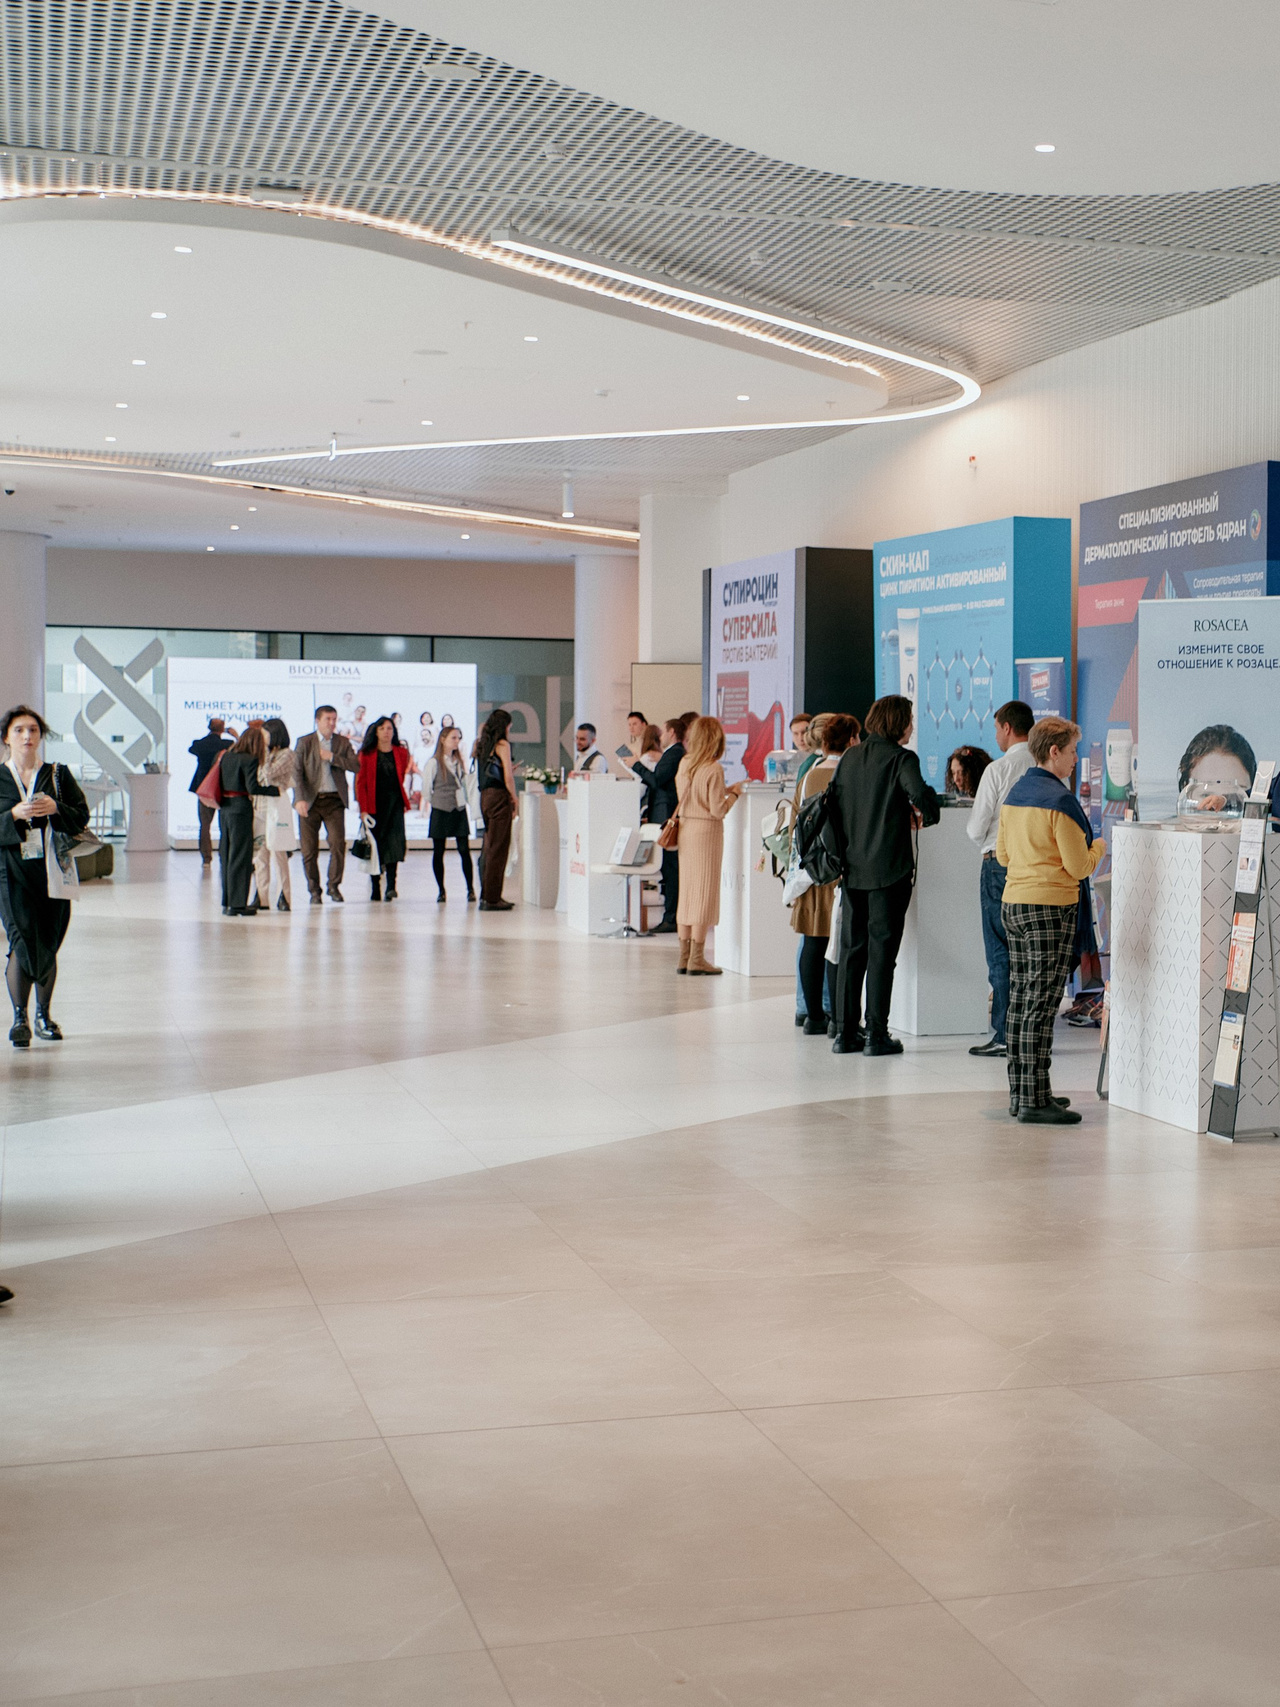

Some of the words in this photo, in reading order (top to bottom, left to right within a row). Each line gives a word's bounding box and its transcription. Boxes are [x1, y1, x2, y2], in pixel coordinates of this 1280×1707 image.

[1119, 491, 1219, 530] СПЕЦИАЛИЗИРОВАННЫЙ
[1084, 530, 1168, 565] ДЕРМАТОЛОГИЧЕСКИЙ
[1170, 525, 1214, 549] ПОРТФЕЛЬ
[1216, 519, 1247, 543] ЯДРАН
[880, 549, 929, 578] СКИН-КАП
[880, 581, 898, 599] ЦИНК
[899, 576, 935, 595] ПИРИТИОН
[936, 561, 1007, 590] АКТИВИРОВАННЫЙ
[1242, 571, 1264, 585] терапия
[723, 572, 779, 607] СУПИРОЦИН
[722, 611, 777, 643] СУПЕРСИЛА
[1194, 619, 1249, 632] ROSACEA
[722, 646, 744, 664] ПРОТИВ
[1178, 644, 1233, 655] ИЗМЕНИТЕ
[1236, 644, 1265, 654] СВОЕ
[289, 665, 361, 675] BIODERMA
[1157, 658, 1223, 669] ОТНОШЕНИЕ
[1226, 658, 1234, 668] К
[184, 701, 233, 711] МЕНЯЕТ
[237, 702, 282, 711] ЖИЗНЬ
